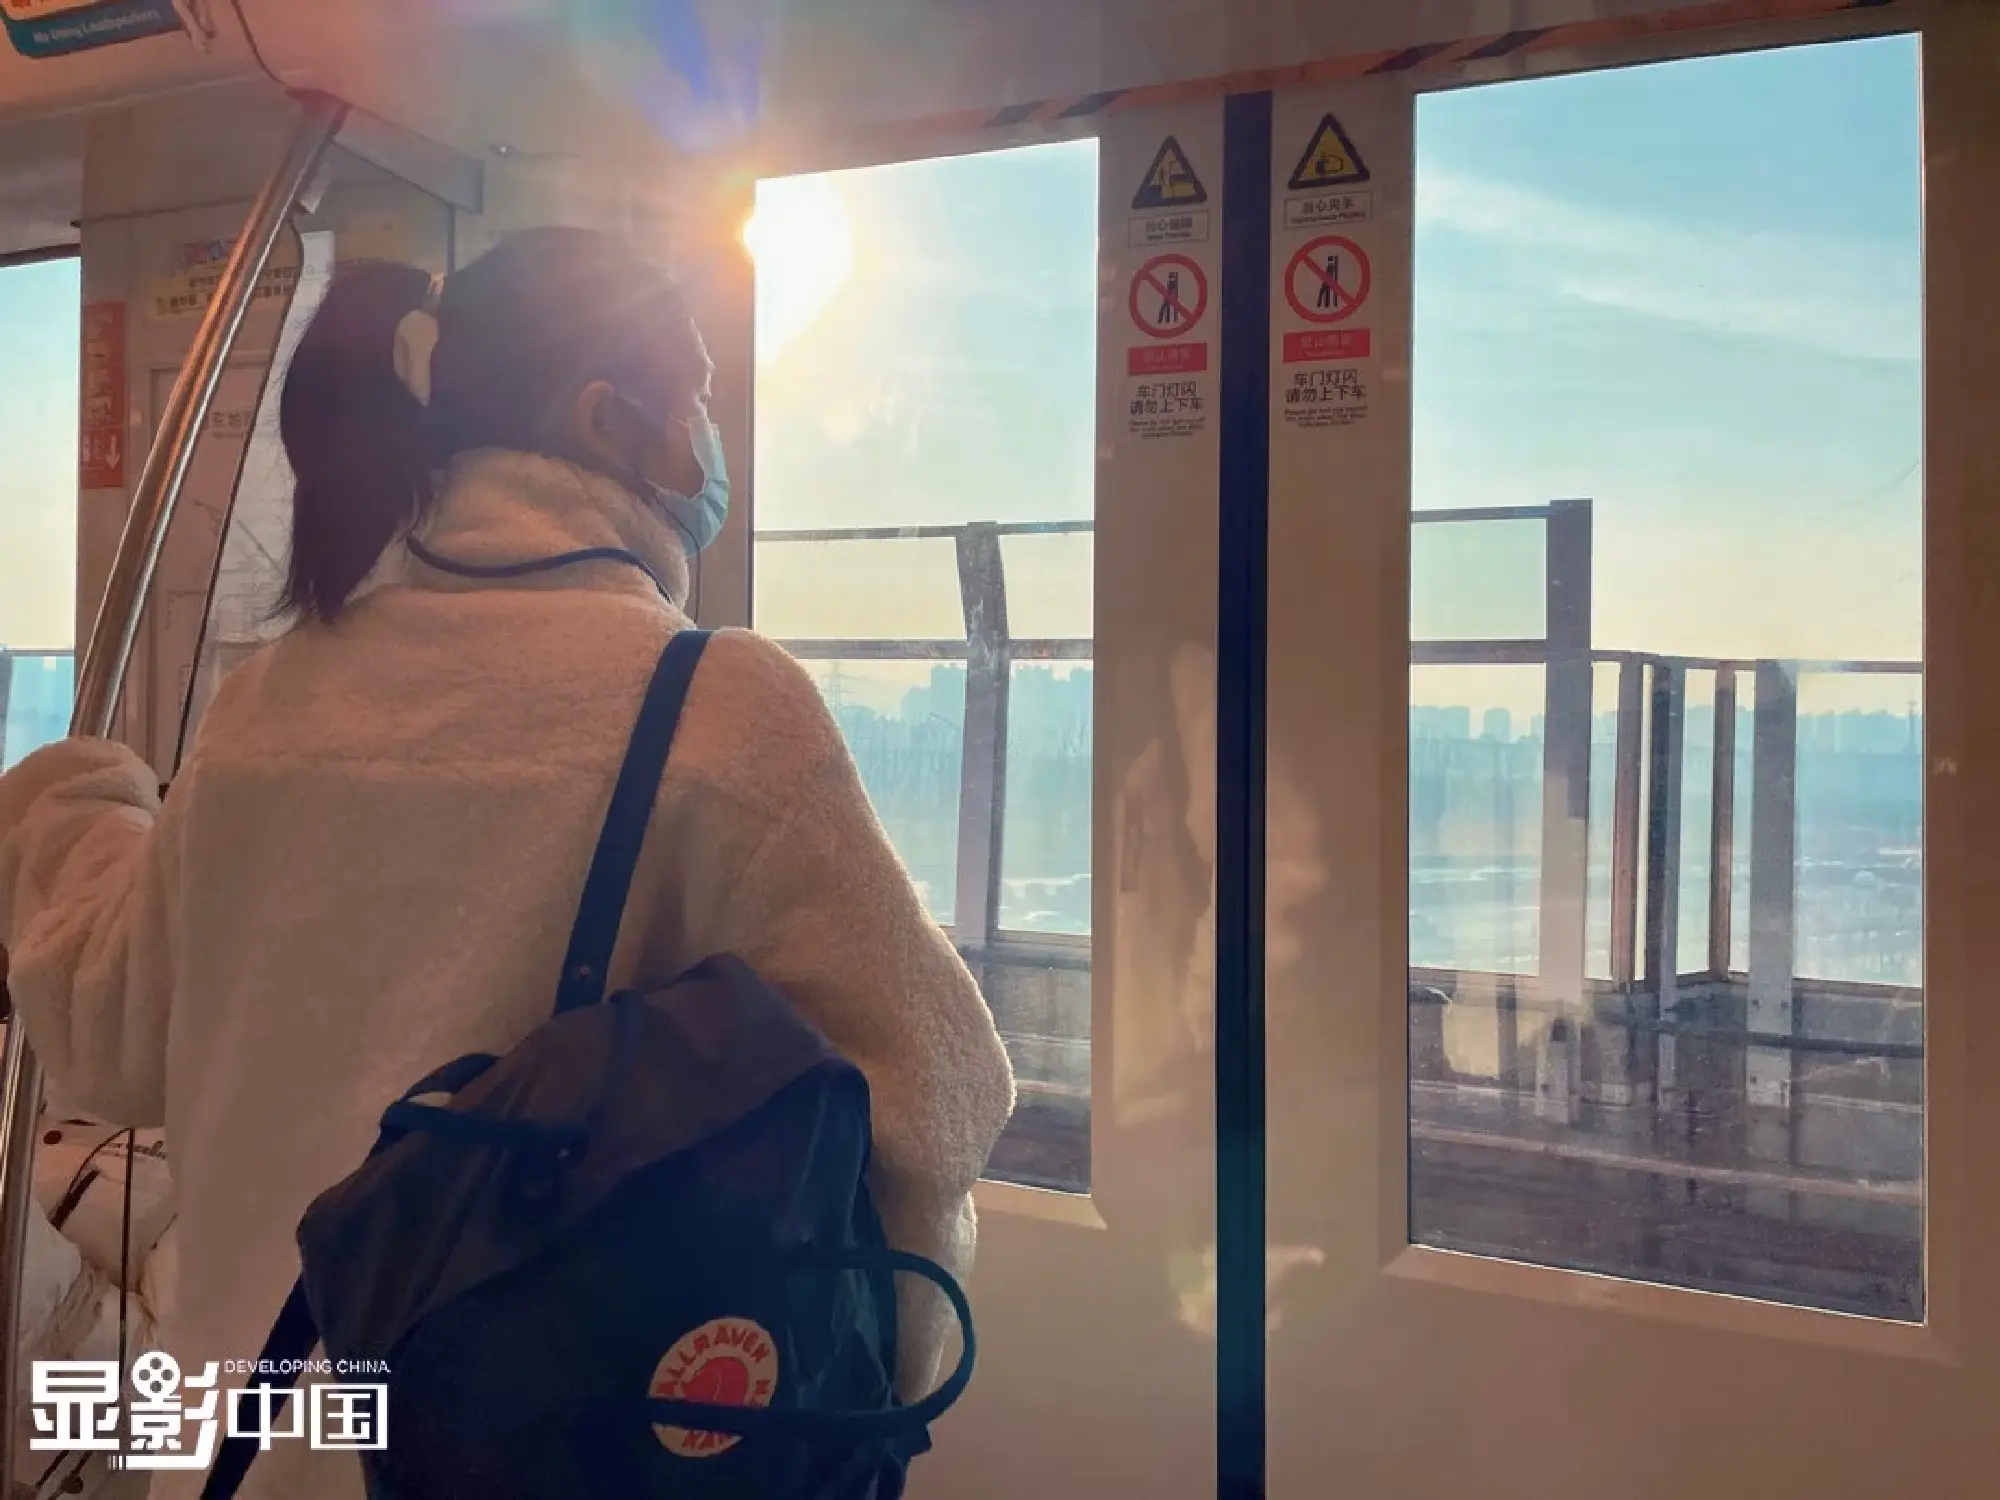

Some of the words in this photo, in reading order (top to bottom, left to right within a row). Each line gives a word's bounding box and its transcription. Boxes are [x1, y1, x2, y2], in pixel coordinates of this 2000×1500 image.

[1293, 369, 1357, 387] 车门灯闪
[1136, 380, 1197, 398] 车门灯闪
[1285, 385, 1366, 404] 请勿上下车
[1130, 397, 1204, 415] 请勿上下车
